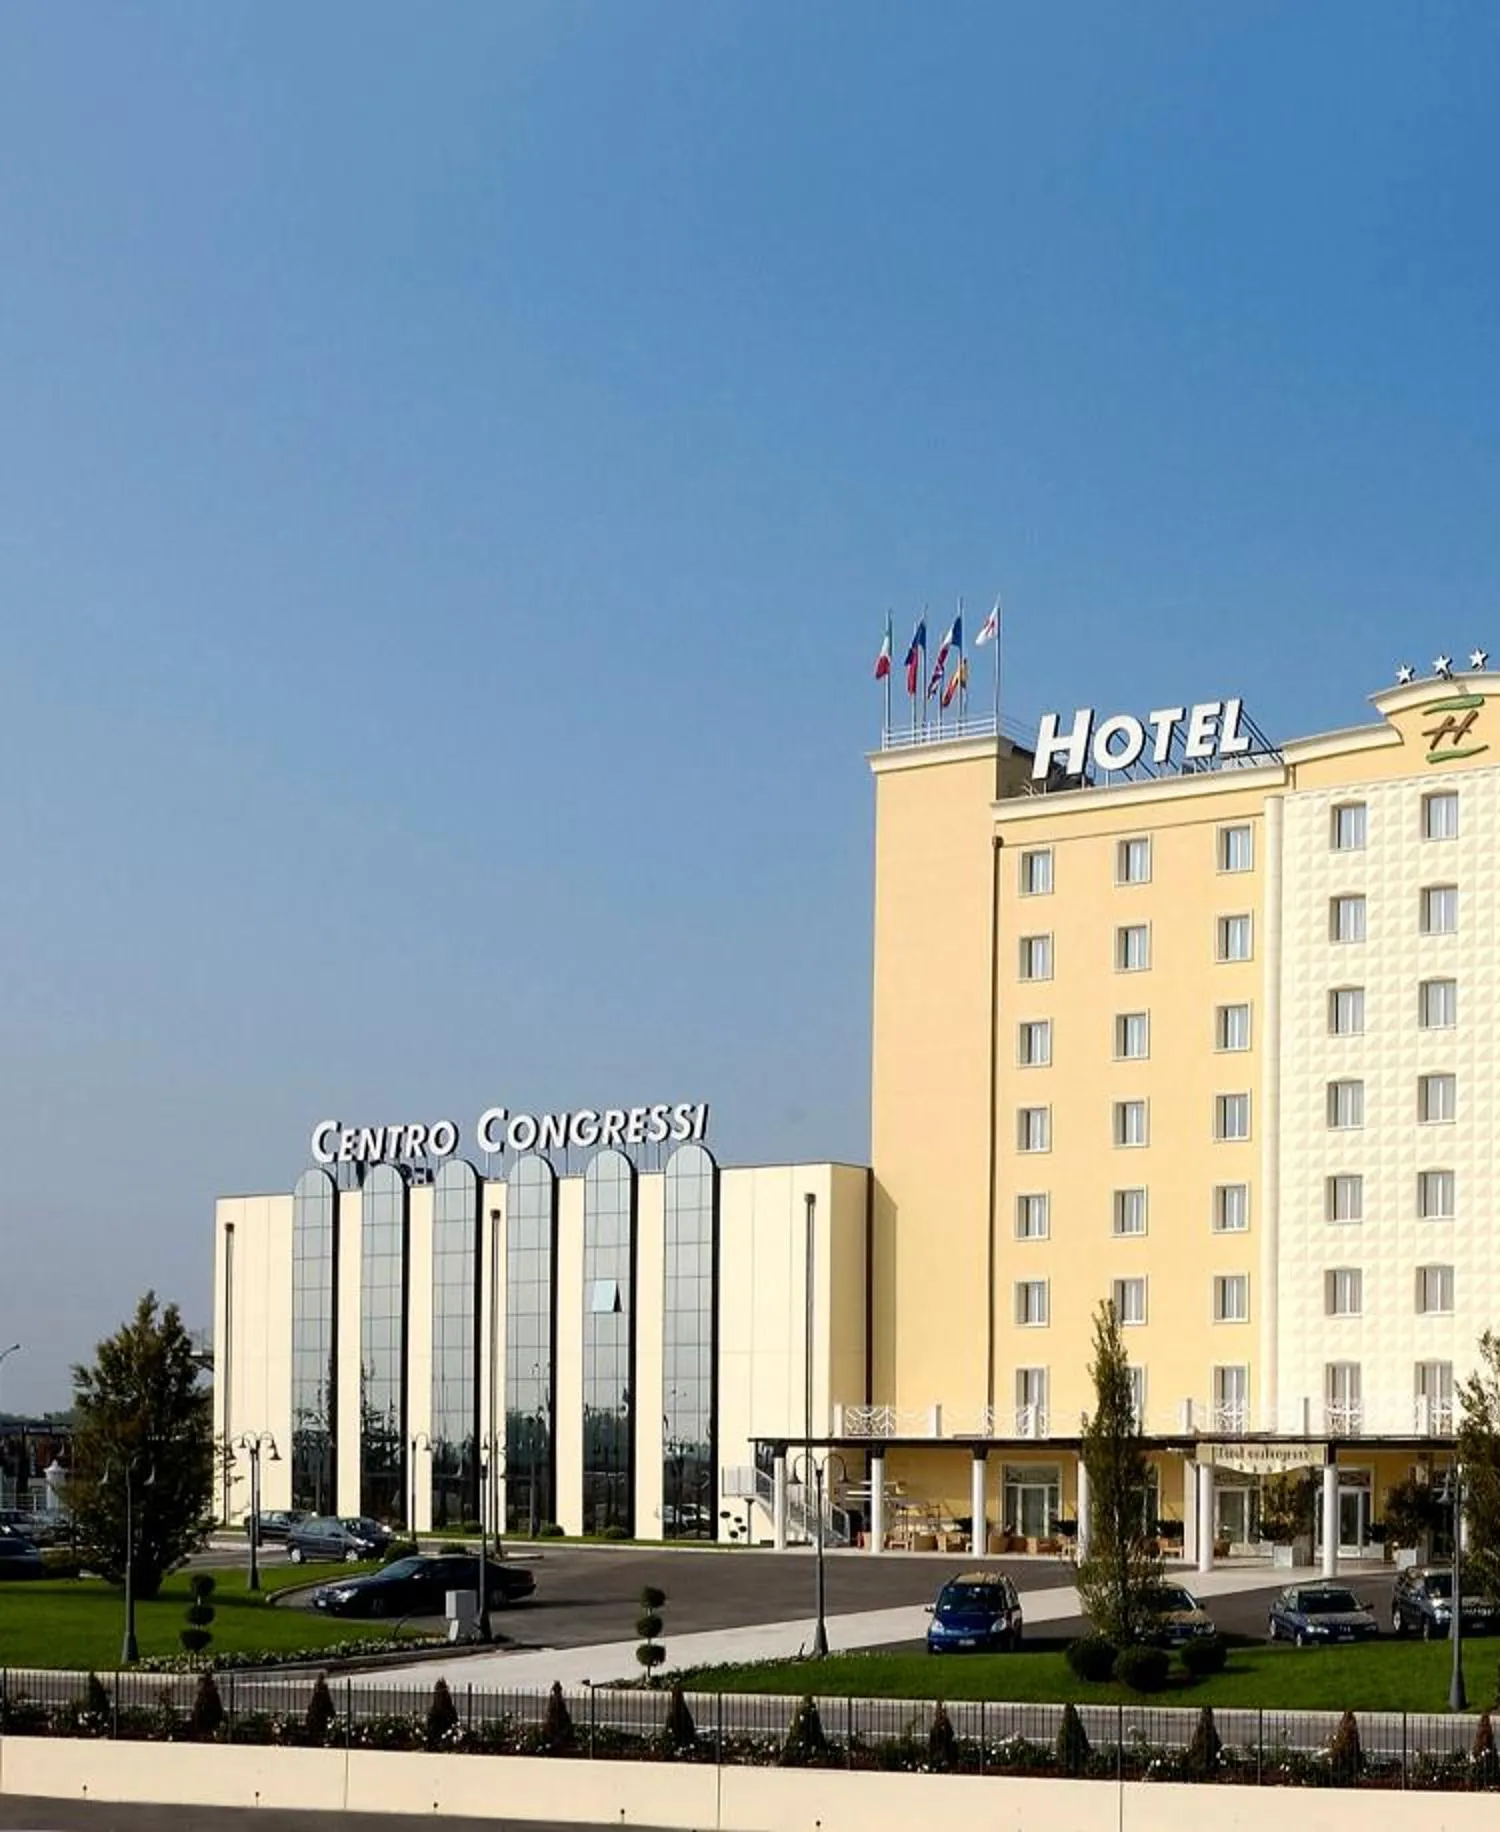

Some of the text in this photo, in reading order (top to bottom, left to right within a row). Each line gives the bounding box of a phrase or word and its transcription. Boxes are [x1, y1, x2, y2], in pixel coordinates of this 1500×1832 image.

[1031, 697, 1252, 780] HOTEL
[311, 1103, 710, 1163] CENTRO CONGRESSI
